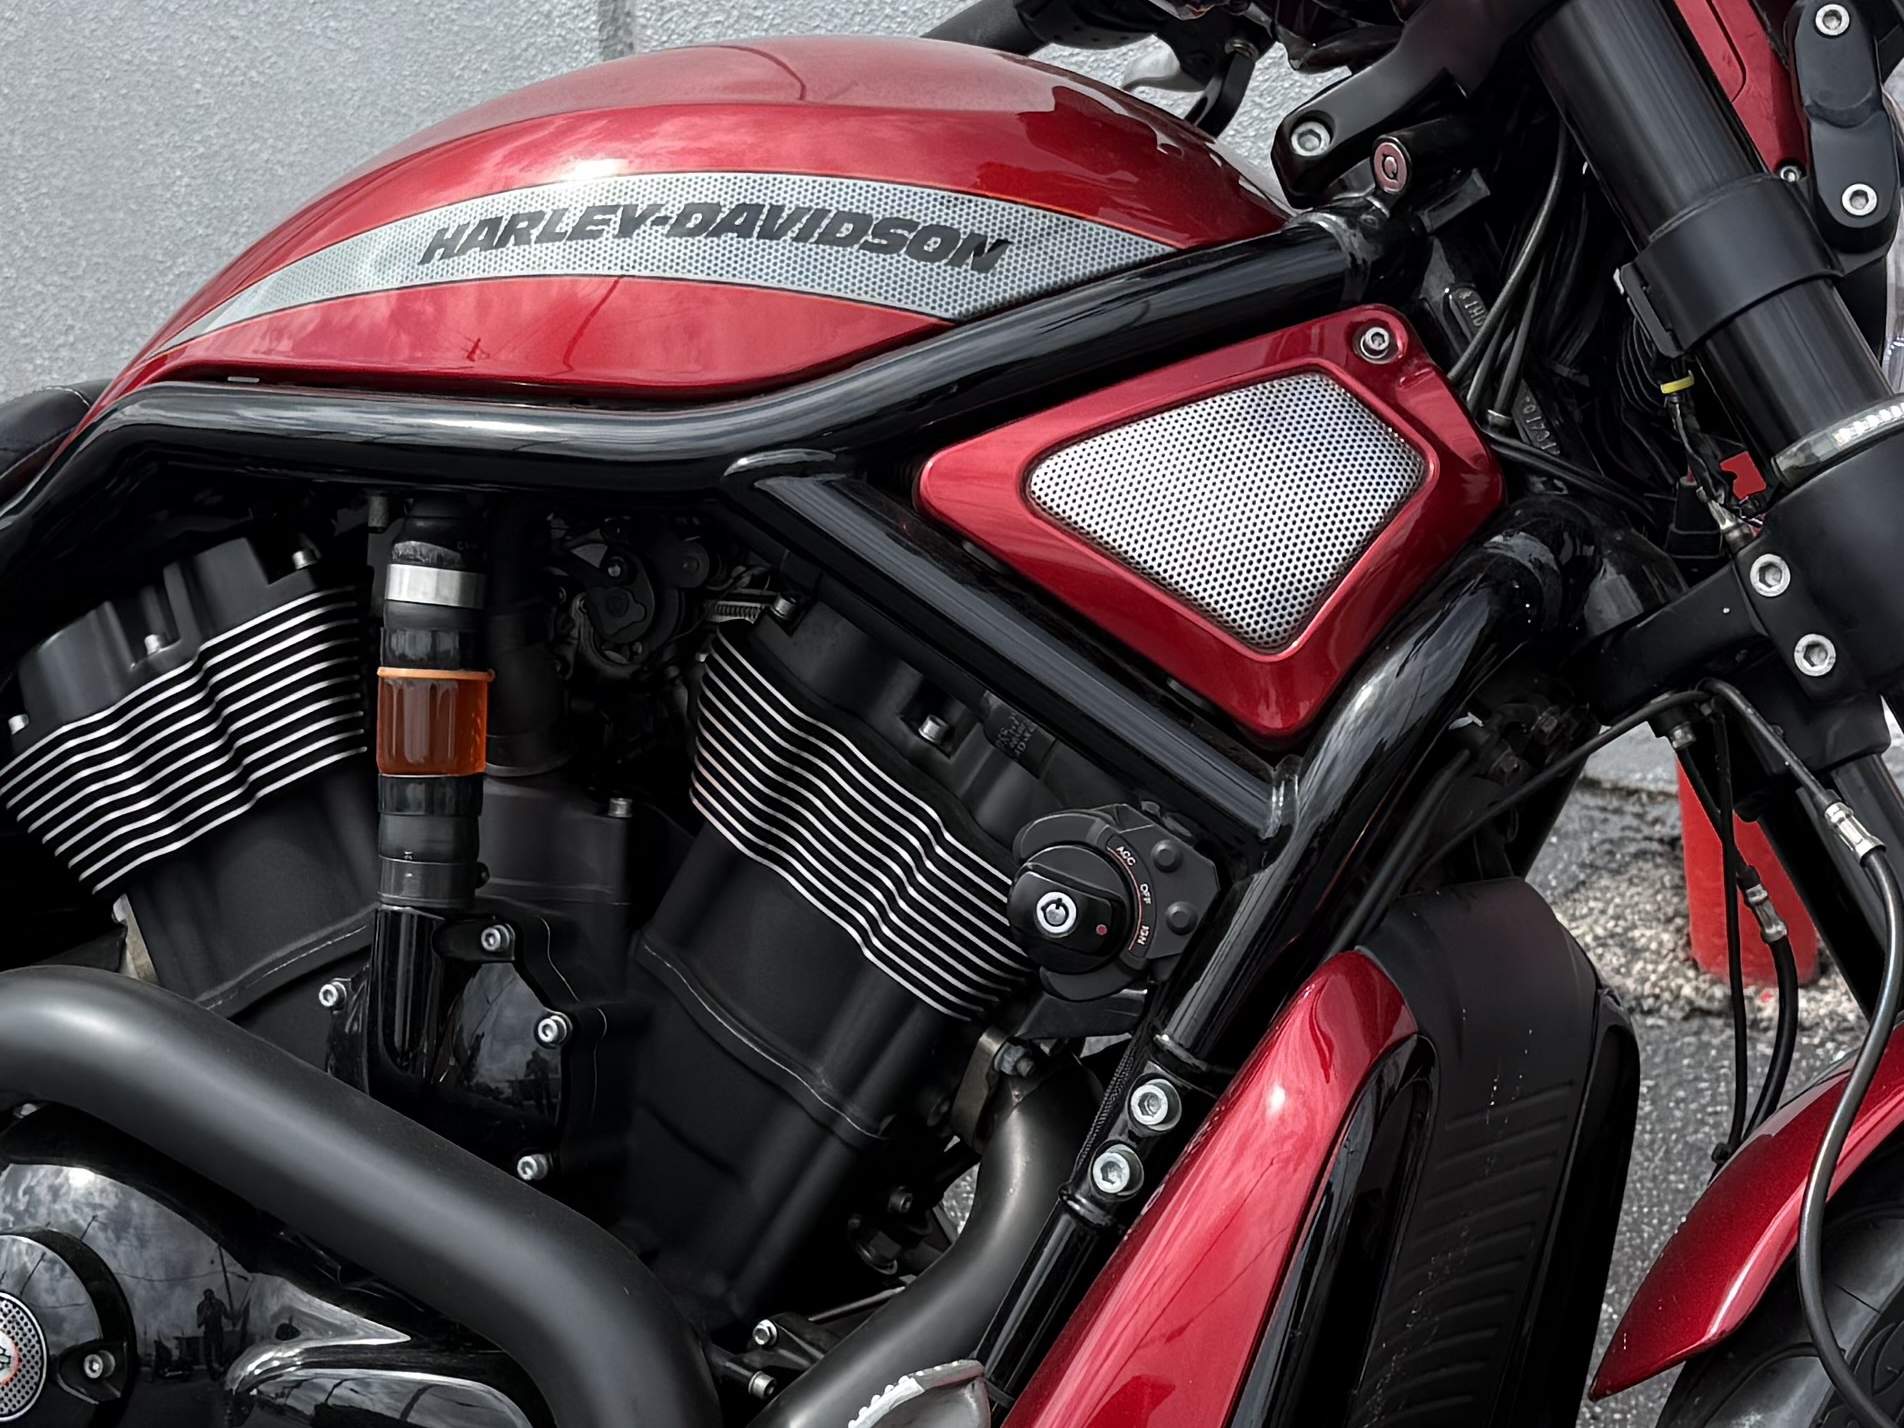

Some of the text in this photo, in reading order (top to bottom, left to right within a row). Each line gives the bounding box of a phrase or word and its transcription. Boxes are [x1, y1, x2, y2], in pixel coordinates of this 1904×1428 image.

[417, 201, 1013, 274] HARLEY-DAVIDSON
[1116, 845, 1136, 866] ACC
[1140, 883, 1152, 905] OFF
[1137, 925, 1150, 946] IGN
